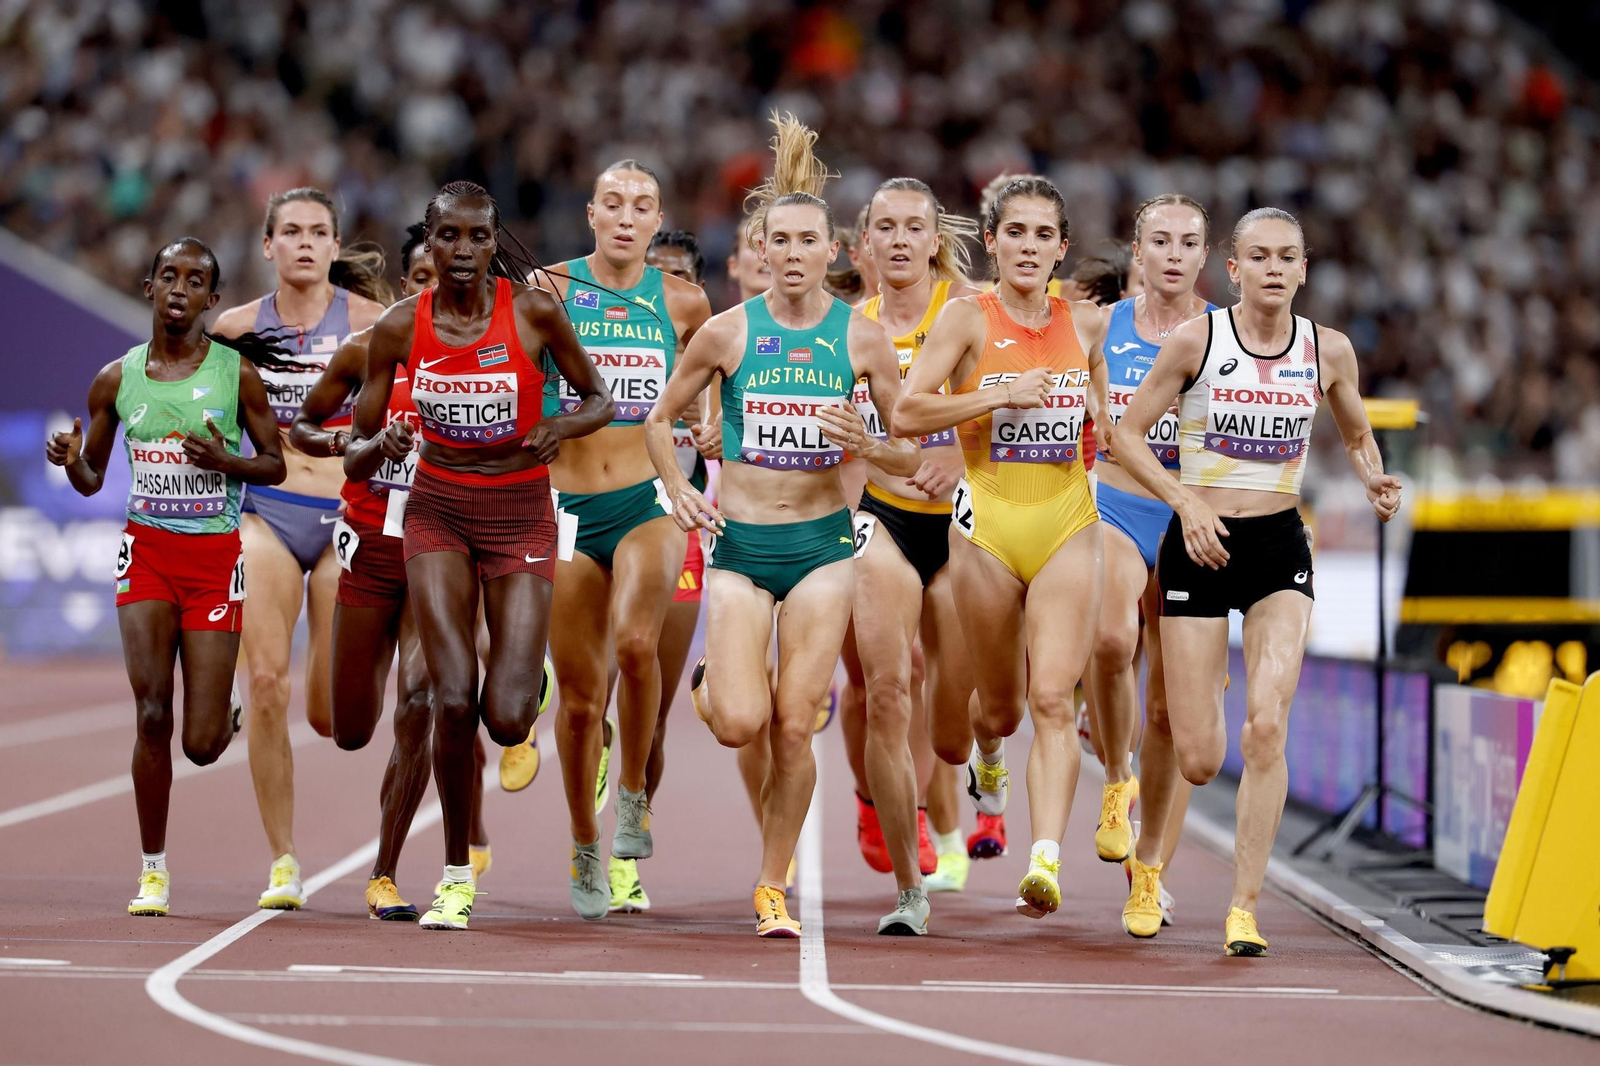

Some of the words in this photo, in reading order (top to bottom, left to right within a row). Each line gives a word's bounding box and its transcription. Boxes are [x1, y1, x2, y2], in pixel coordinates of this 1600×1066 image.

[572, 322, 664, 344] USTRALIA
[746, 368, 843, 392] AUSTRALIA
[1278, 370, 1304, 378] Allianz
[415, 377, 515, 394] HONDA
[1211, 388, 1313, 407] HONDA
[418, 400, 511, 424] NGETICH
[745, 401, 840, 417] HON
[758, 425, 830, 449] HALL
[1213, 413, 1256, 437] VAN
[1260, 416, 1308, 439] LENT
[132, 449, 193, 465] HON
[136, 472, 181, 495] HASSAN
[185, 472, 223, 495] NOUR
[338, 531, 350, 561] 8
